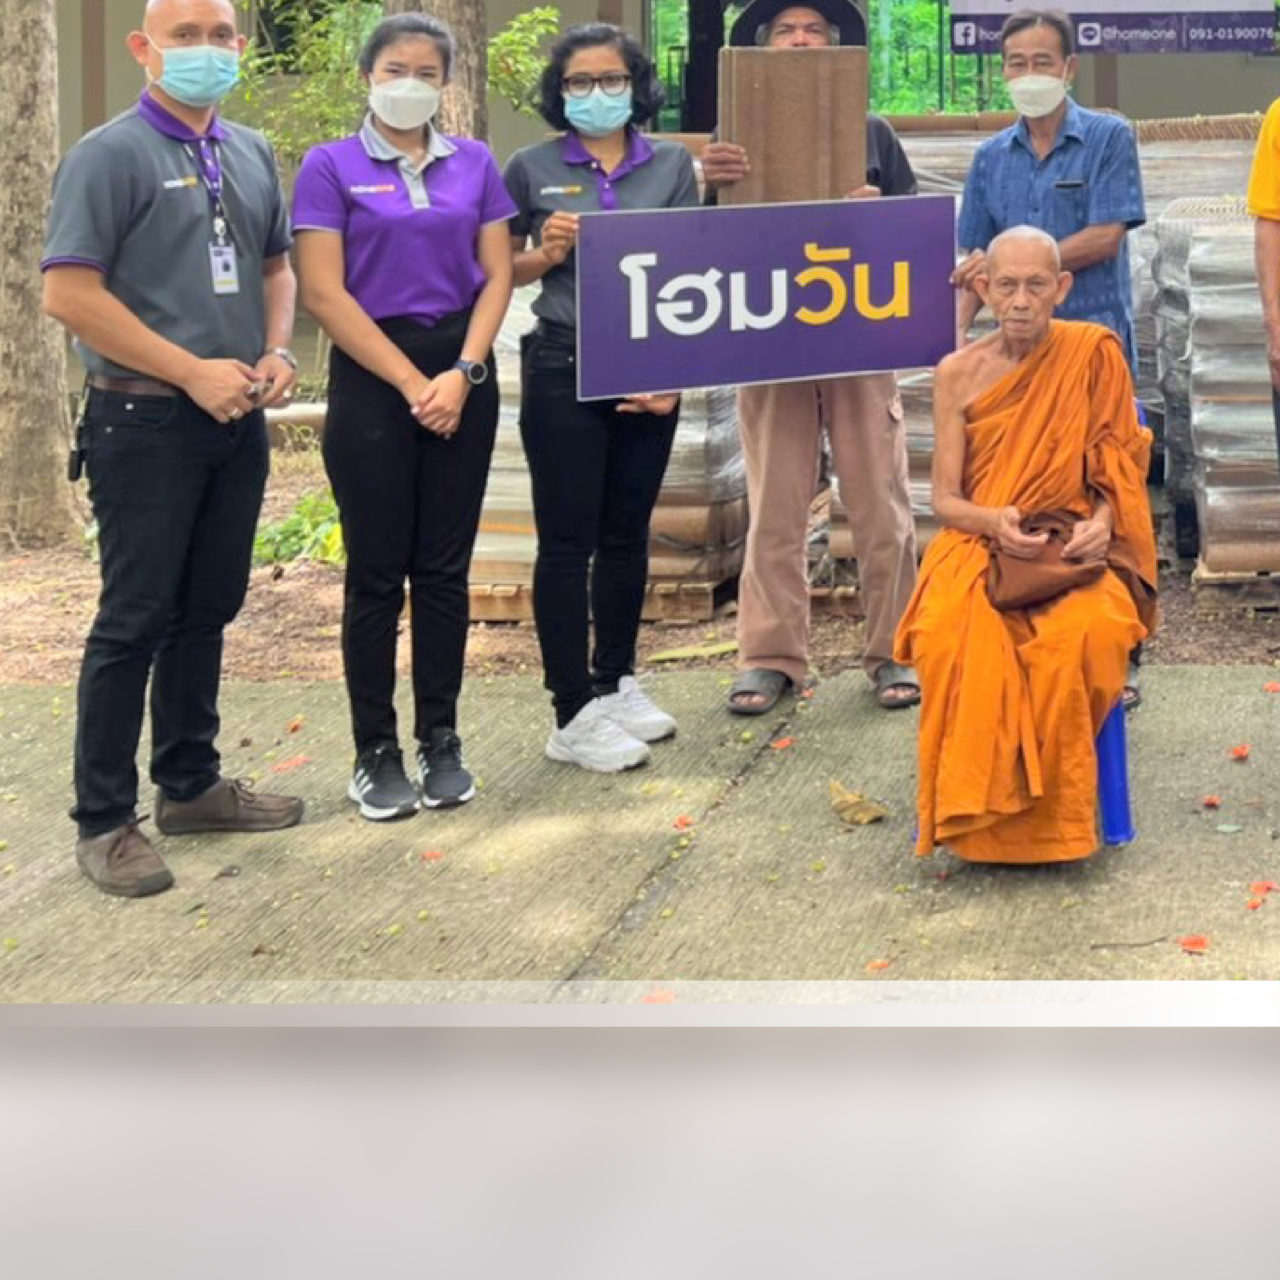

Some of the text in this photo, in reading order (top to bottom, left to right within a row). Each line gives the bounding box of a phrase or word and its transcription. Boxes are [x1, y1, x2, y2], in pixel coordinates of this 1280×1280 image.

[1103, 25, 1176, 40] @homeone
[1189, 27, 1274, 40] 091-0190076
[619, 242, 910, 339] โฮมวัน
